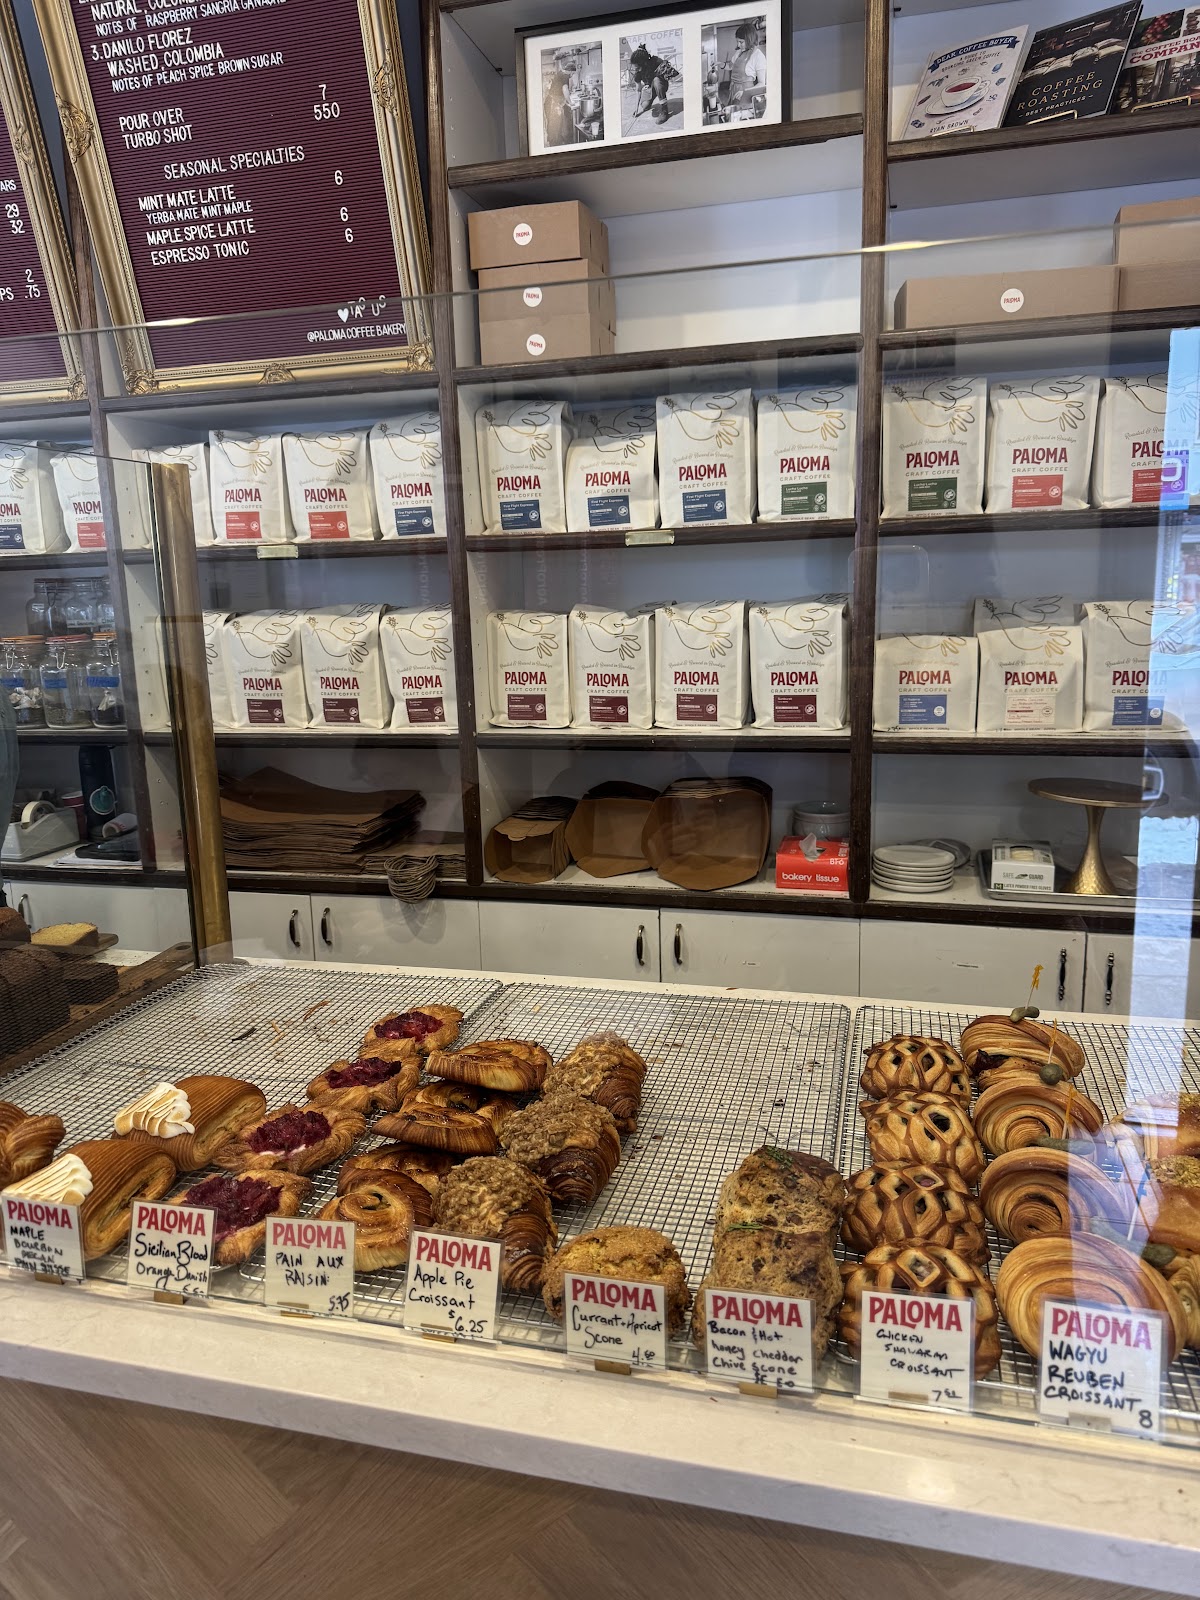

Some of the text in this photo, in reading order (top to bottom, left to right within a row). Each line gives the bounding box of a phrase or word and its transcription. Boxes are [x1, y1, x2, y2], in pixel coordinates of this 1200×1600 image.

[95, 21, 123, 36] NOTES
[126, 17, 137, 31] OF
[145, 6, 198, 27] RASPBERRY
[200, 0, 240, 17] SANGRIA
[148, 27, 193, 50] FLOREZ
[936, 51, 957, 64] DEAR
[959, 40, 988, 55] COFFEE
[112, 77, 140, 93] NOTES
[142, 75, 153, 88] OF
[157, 69, 187, 86] PEACH
[189, 63, 215, 80] SPICE
[1031, 71, 1096, 97] COFFEE
[318, 84, 327, 101] 7
[1016, 79, 1103, 111] ROASTING
[119, 108, 184, 131] POUR OVER
[313, 102, 340, 120] 550
[122, 124, 193, 149] TURBO SHOT
[164, 145, 305, 180] SEASONAL SPECIALTIES
[334, 170, 344, 186] 6
[138, 184, 237, 212] MINT MATE LATTE
[5, 203, 20, 219] 29
[146, 200, 253, 225] YERBA MATE MINT MAPLE
[340, 206, 349, 222] 6
[9, 219, 25, 234] 32
[146, 218, 256, 246] MAPLE SPICE LATTE
[344, 227, 354, 243] 6
[151, 240, 249, 266] ESPRESSO TONIC
[25, 268, 35, 283] 2
[780, 455, 830, 473] PALOMA
[905, 449, 960, 469] PALOMA
[1012, 447, 1069, 465] PALOMA
[585, 470, 631, 487] PALOMA
[678, 463, 728, 481] PALOMA
[390, 482, 433, 499] PALOMA
[497, 475, 542, 492] PALOMA
[224, 488, 262, 503] PALOMA
[303, 488, 348, 503] PALOMA
[242, 677, 282, 691] PALOMA
[320, 676, 360, 691] PALOMA
[401, 675, 443, 689] PALOMA
[504, 671, 547, 686] PALOMA
[586, 673, 630, 688] PALOMA
[673, 671, 719, 687] PALOMA
[770, 670, 819, 687] PALOMA
[898, 670, 952, 686] PALOMA
[1004, 671, 1058, 686] PALOMA
[781, 871, 840, 883] bakery tissue
[7, 1200, 73, 1229] PALOMA
[137, 1205, 206, 1236] PALOMA
[10, 1226, 45, 1241] MAPLE
[272, 1222, 347, 1250] PALOMA
[135, 1232, 208, 1266] Sicilian Blood
[416, 1236, 492, 1272] PALOMA
[276, 1252, 344, 1269] PAIN AUX
[136, 1261, 174, 1290] Orange
[174, 1264, 207, 1282] Danish
[414, 1264, 474, 1290] Apple Pie
[328, 1291, 351, 1312] 5.75
[408, 1287, 476, 1310] Croissant
[571, 1278, 658, 1313] PALOMA
[711, 1294, 804, 1328] PALOMA
[869, 1296, 963, 1332] PALOMA
[584, 1325, 623, 1349] Scone
[707, 1320, 747, 1337] Bacon
[759, 1330, 784, 1342] Hot
[876, 1328, 924, 1344] CHICKEN
[1051, 1307, 1152, 1350] PALOMA
[1049, 1340, 1108, 1365] WAGYU
[712, 1356, 746, 1371] Chive
[890, 1358, 965, 1379] CROISSANT
[1047, 1364, 1125, 1391] REUBEN
[1043, 1385, 1143, 1412] CROISSANT
[1138, 1408, 1153, 1429] 8
